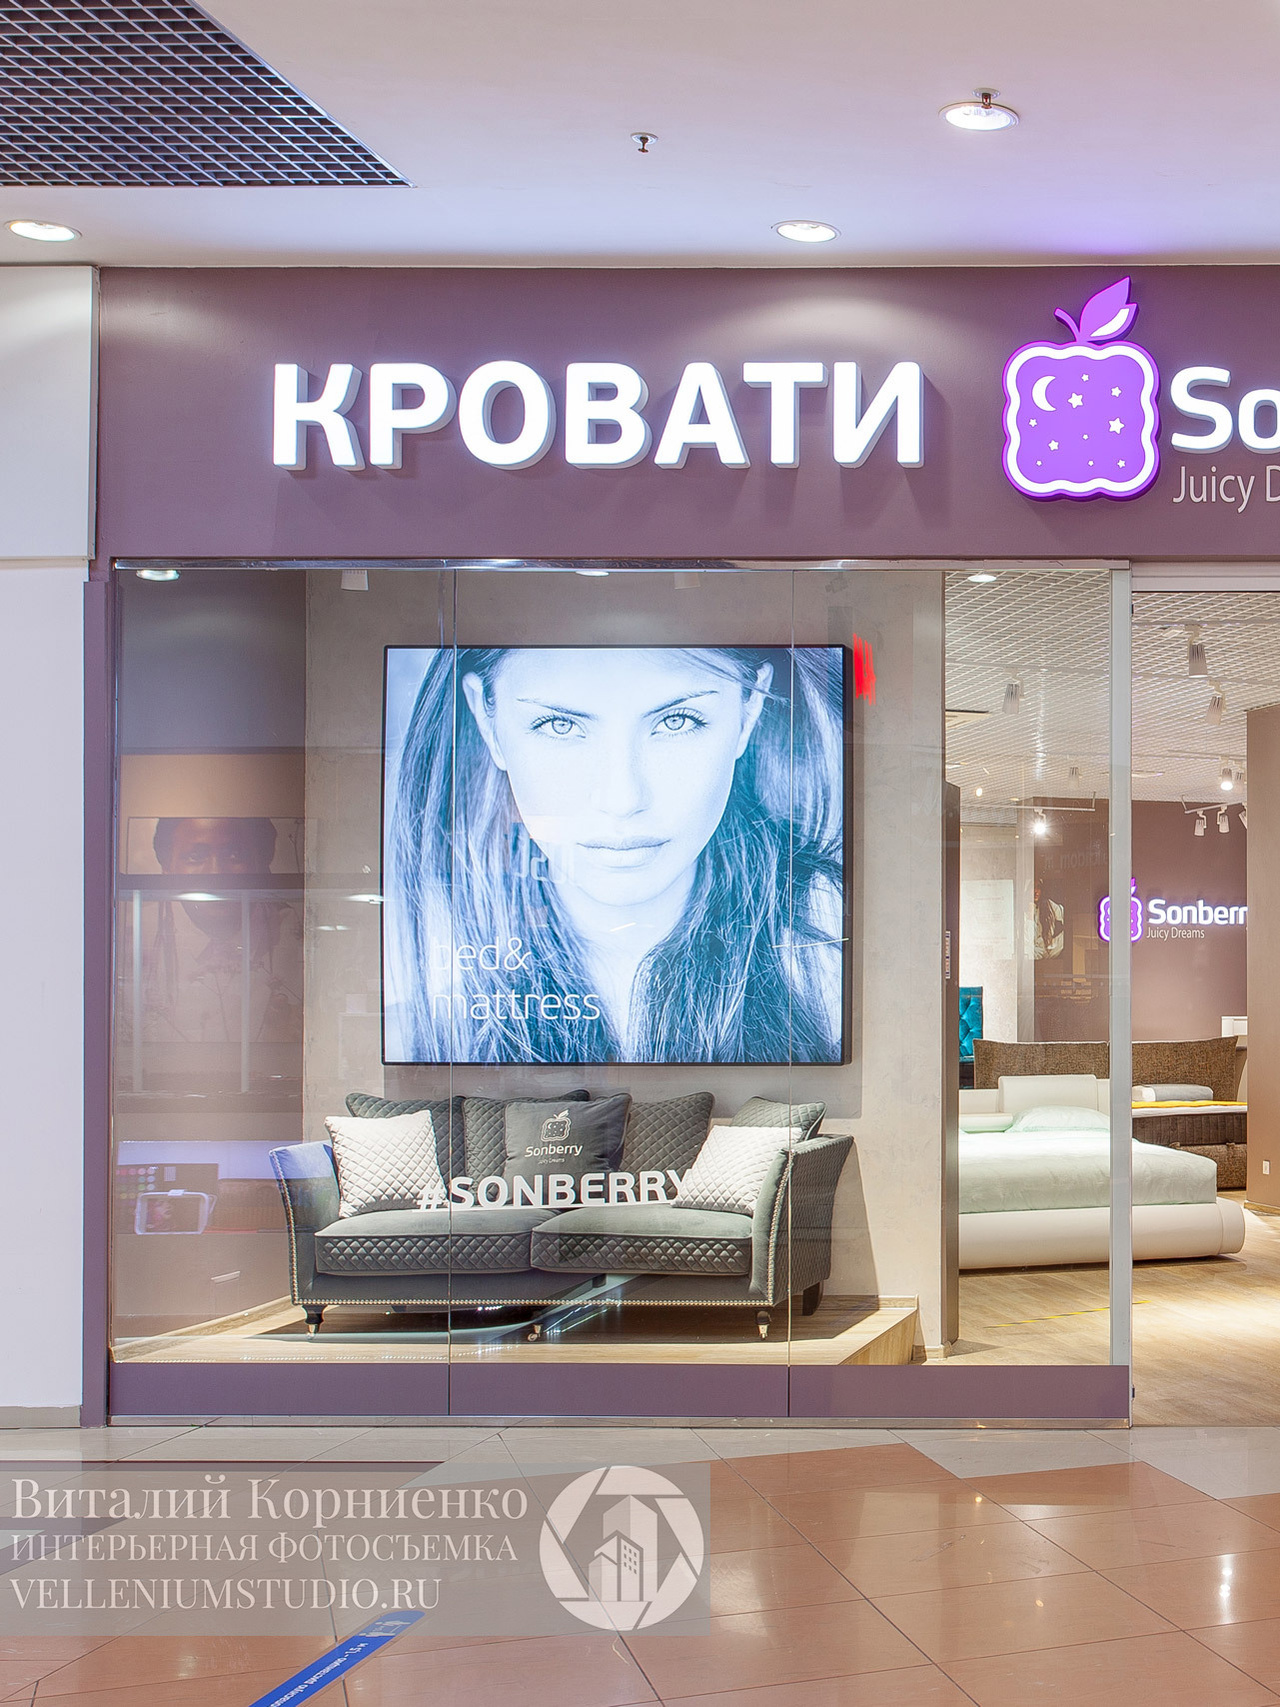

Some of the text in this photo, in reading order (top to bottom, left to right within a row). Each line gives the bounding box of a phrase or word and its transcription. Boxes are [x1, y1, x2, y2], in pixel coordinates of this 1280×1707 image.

[272, 360, 924, 470] КРОВАТИ
[1173, 465, 1256, 513] Juicy
[1148, 898, 1248, 926] Sonberr
[1146, 926, 1205, 941] Juicy Dreams
[432, 988, 600, 1020] mattress
[524, 1143, 583, 1158] Sonberry
